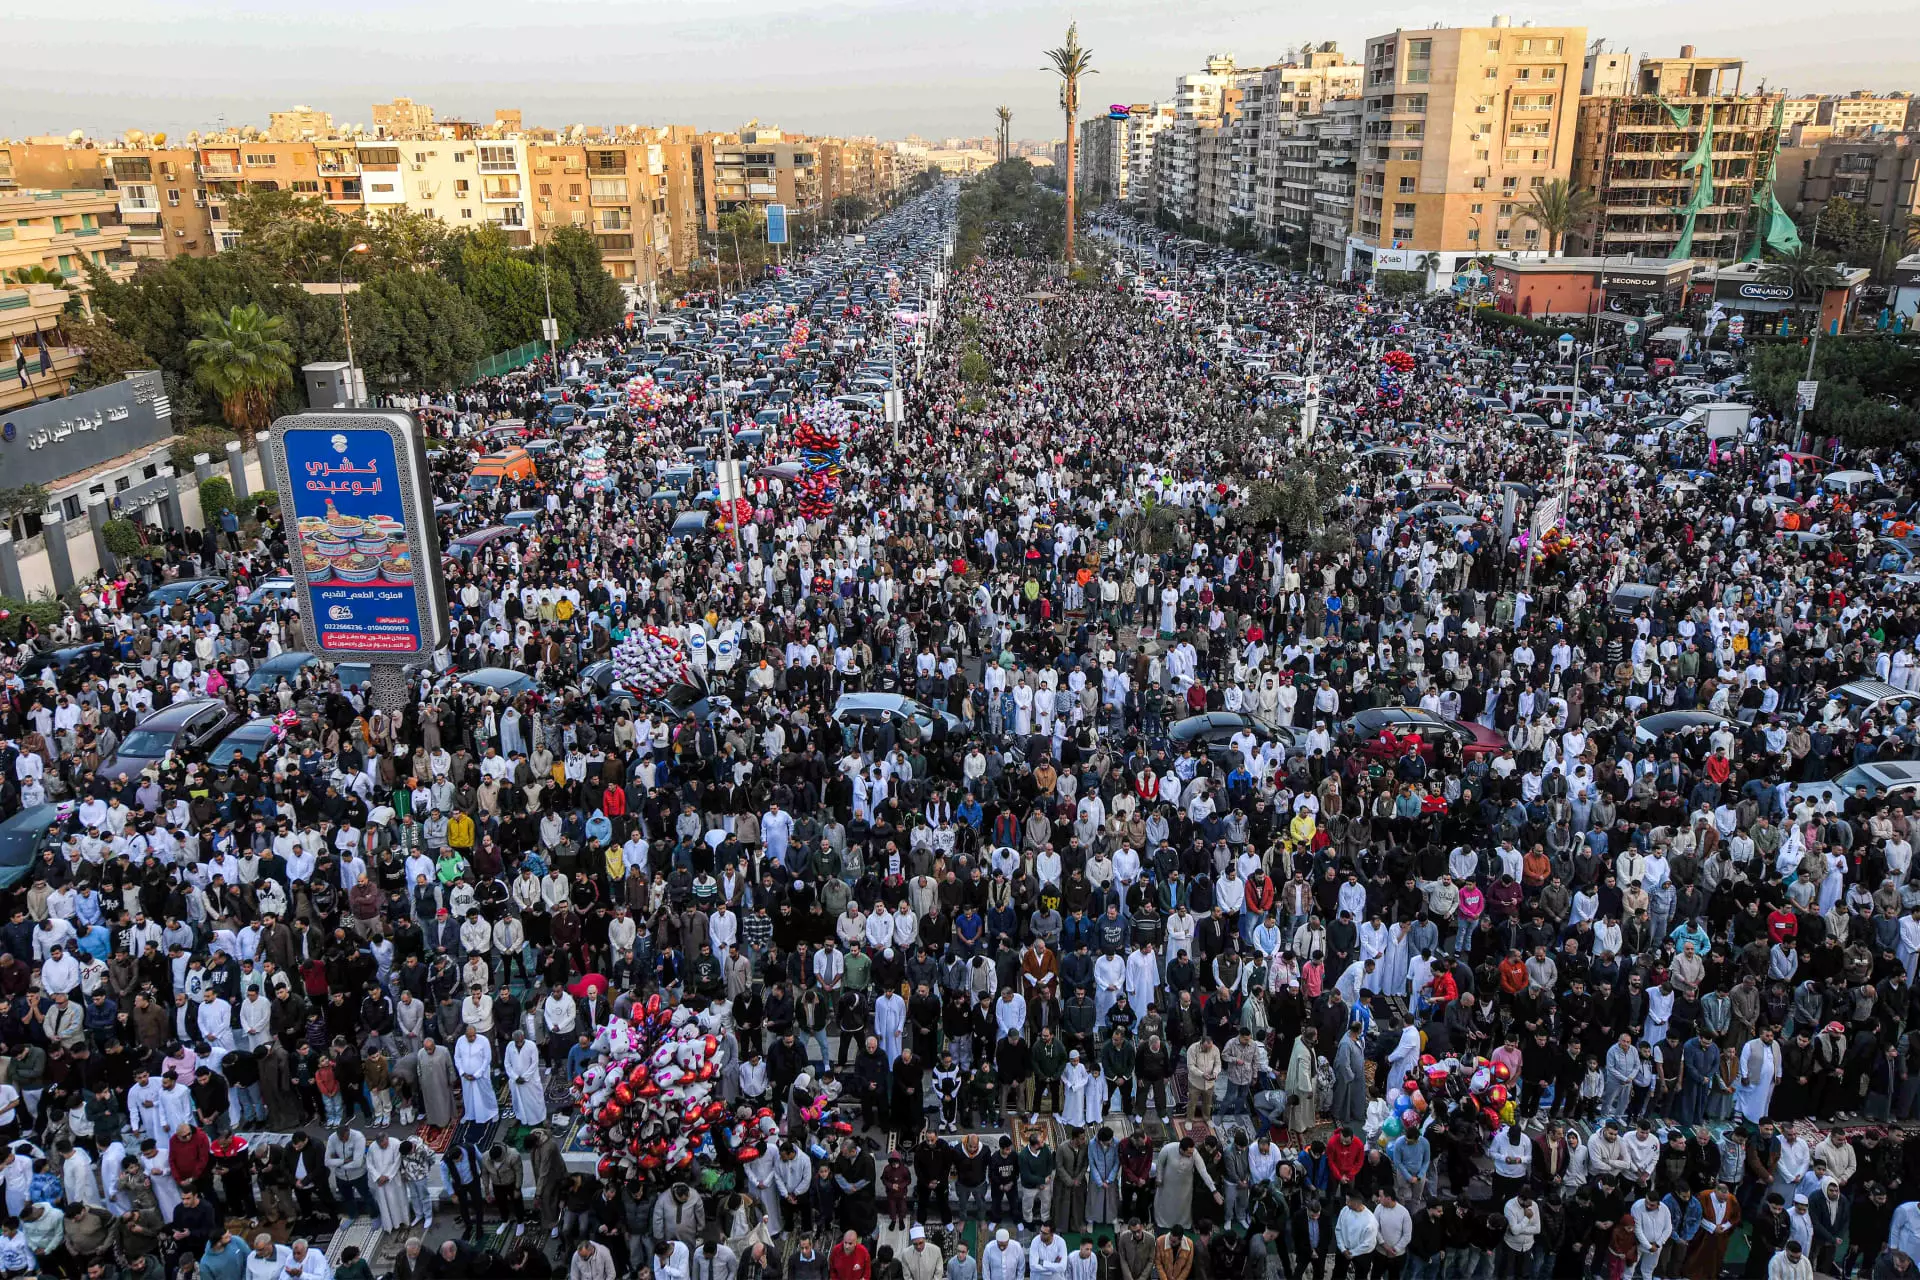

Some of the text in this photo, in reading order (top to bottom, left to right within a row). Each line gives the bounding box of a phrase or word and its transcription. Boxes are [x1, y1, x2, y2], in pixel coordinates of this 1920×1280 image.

[1612, 277, 1641, 285] SECOND
[1744, 286, 1789, 296] CINNABON
[75, 409, 103, 431] شرطة
[27, 420, 75, 451] الشيراتون
[305, 456, 378, 477] كشري
[337, 606, 350, 615] 24
